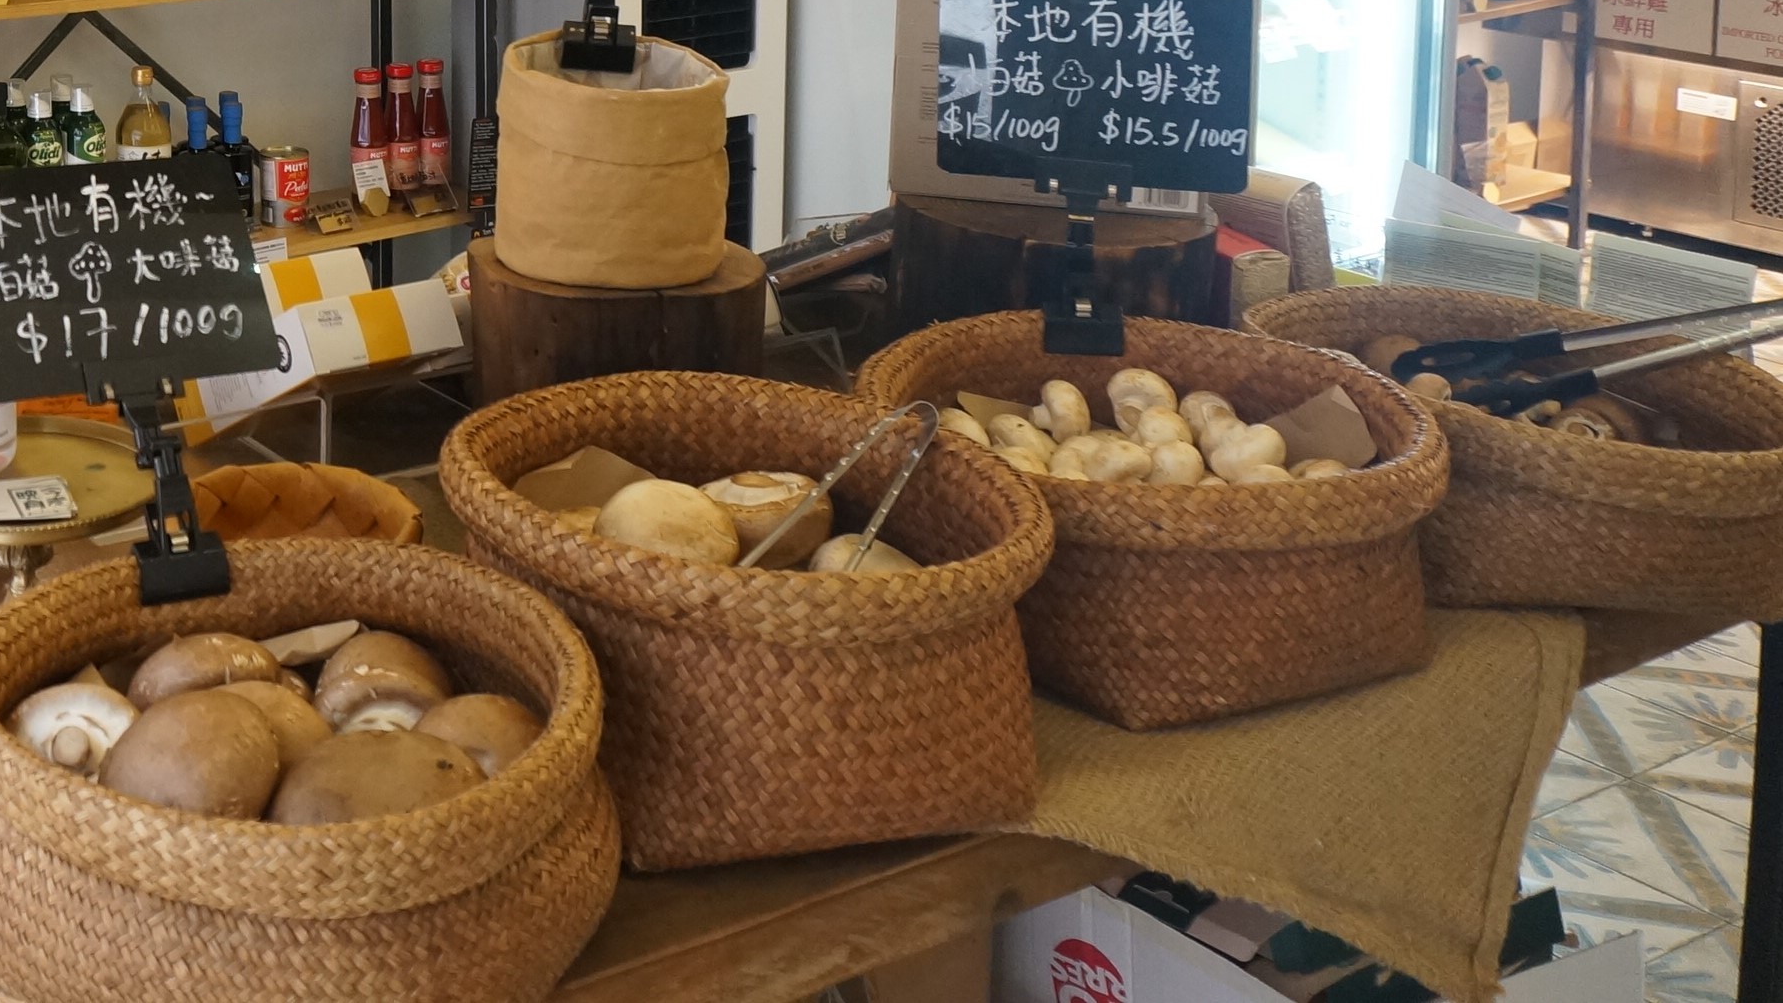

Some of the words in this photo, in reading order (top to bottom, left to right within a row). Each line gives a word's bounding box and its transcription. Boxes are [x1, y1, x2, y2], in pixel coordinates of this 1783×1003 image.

[1612, 14, 1655, 39] 專用
[1721, 26, 1776, 42] IMPORTED
[1101, 59, 1221, 105] 小啡菇
[940, 102, 1060, 152] $15/100g
[1098, 107, 1248, 155] $15.5/100g
